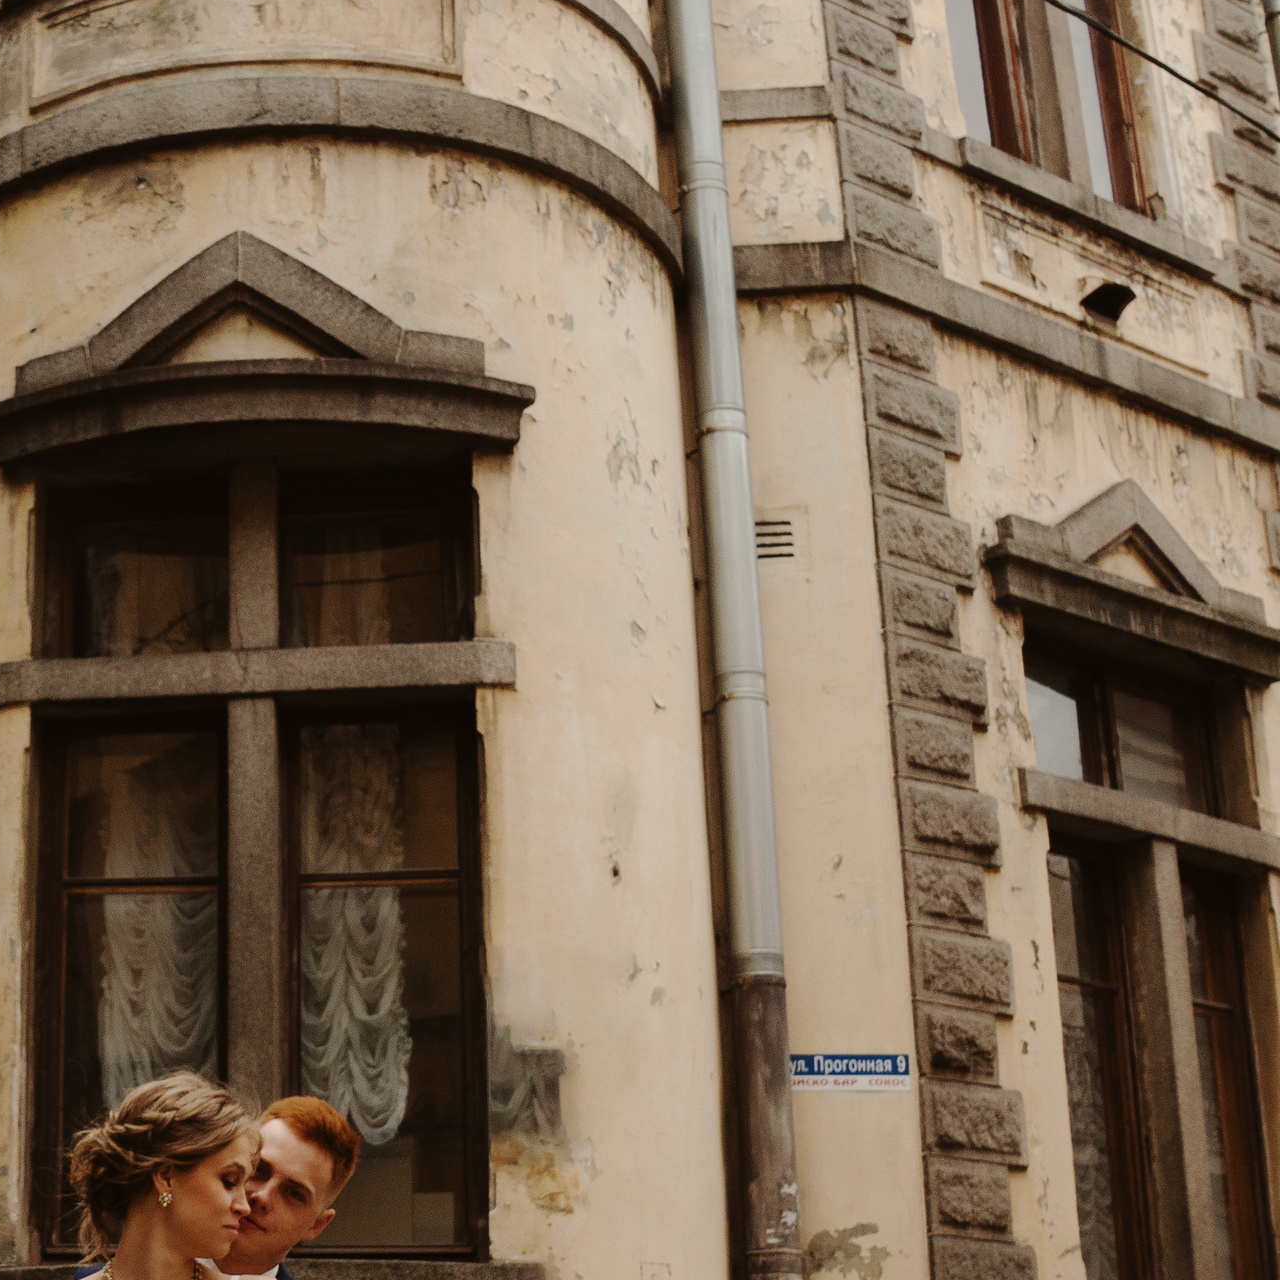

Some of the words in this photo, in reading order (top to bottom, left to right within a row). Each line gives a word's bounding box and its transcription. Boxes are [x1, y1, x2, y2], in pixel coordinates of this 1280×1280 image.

[791, 1059, 809, 1074] ул.
[813, 1055, 892, 1075] Прогонная
[897, 1055, 907, 1073] 9
